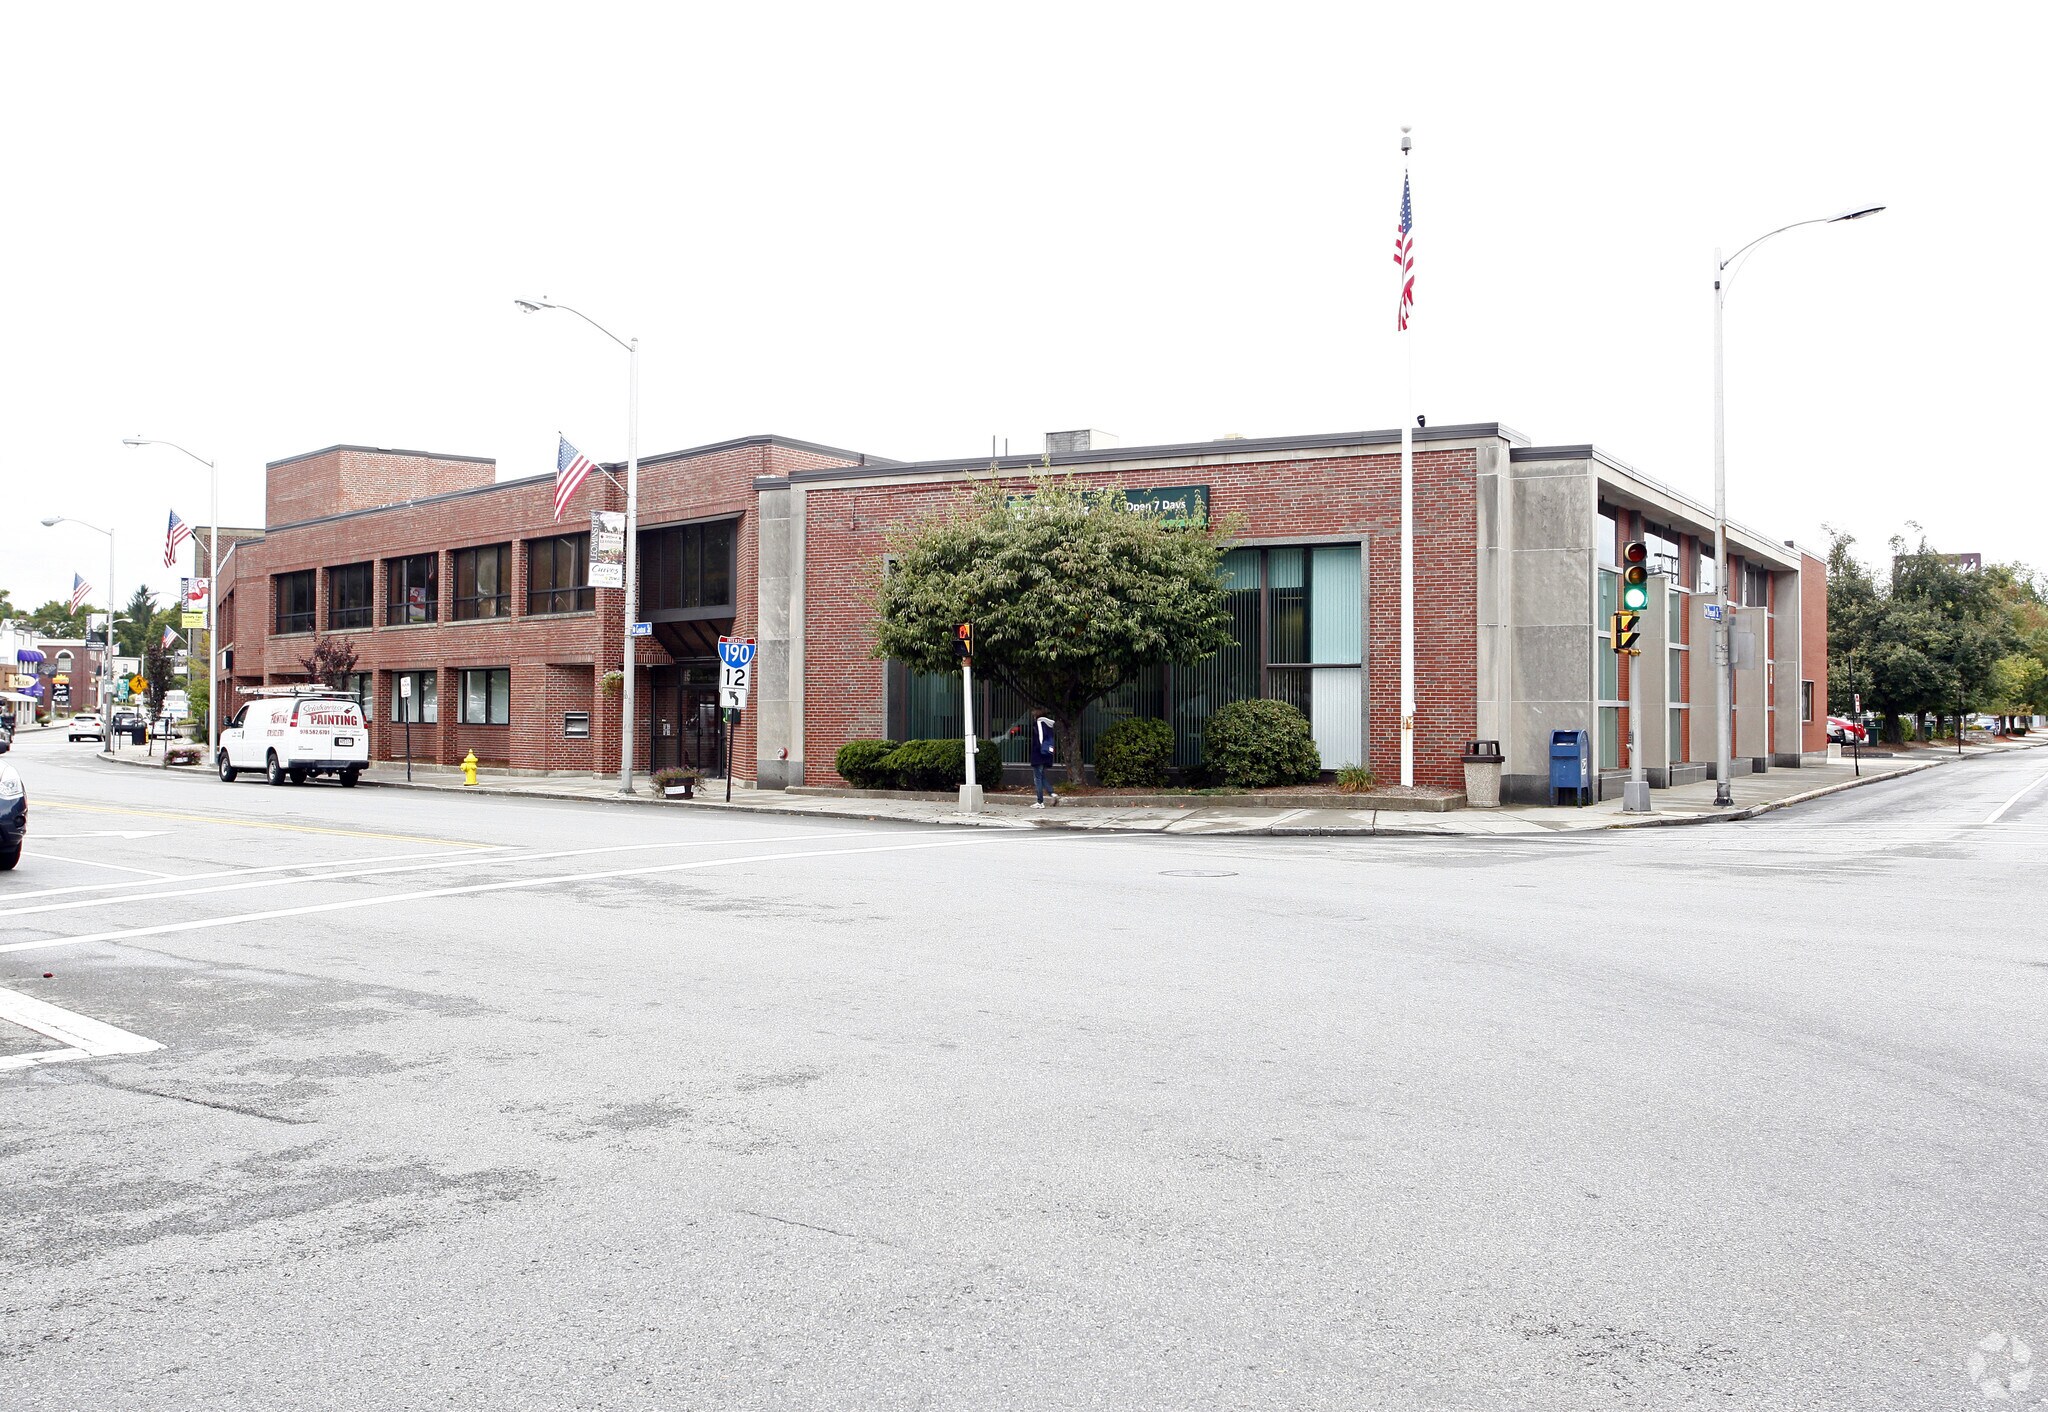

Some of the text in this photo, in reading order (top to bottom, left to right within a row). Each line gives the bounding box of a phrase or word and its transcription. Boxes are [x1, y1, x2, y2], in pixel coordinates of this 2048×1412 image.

[1126, 500, 1186, 513] Open 7 Days
[590, 514, 600, 561] LEOMINSTER
[725, 644, 750, 663] 190
[725, 668, 745, 687] 12
[310, 714, 358, 726] PAINTING
